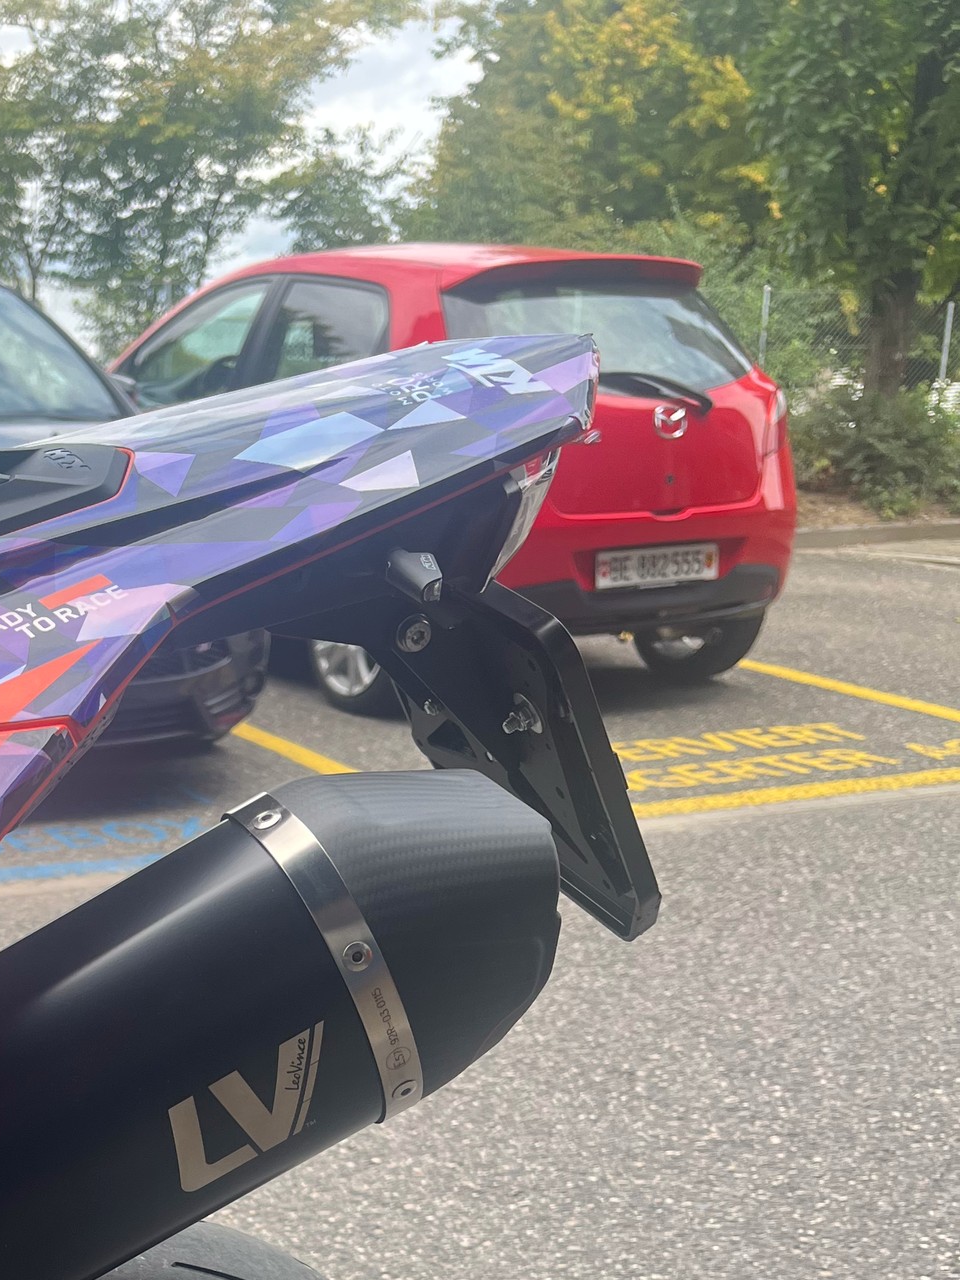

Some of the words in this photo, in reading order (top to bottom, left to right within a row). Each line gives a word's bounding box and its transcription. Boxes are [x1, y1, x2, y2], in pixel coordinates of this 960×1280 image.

[15, 616, 56, 639] TO
[53, 584, 129, 624] RACE
[284, 1037, 307, 1092] LeoVince
